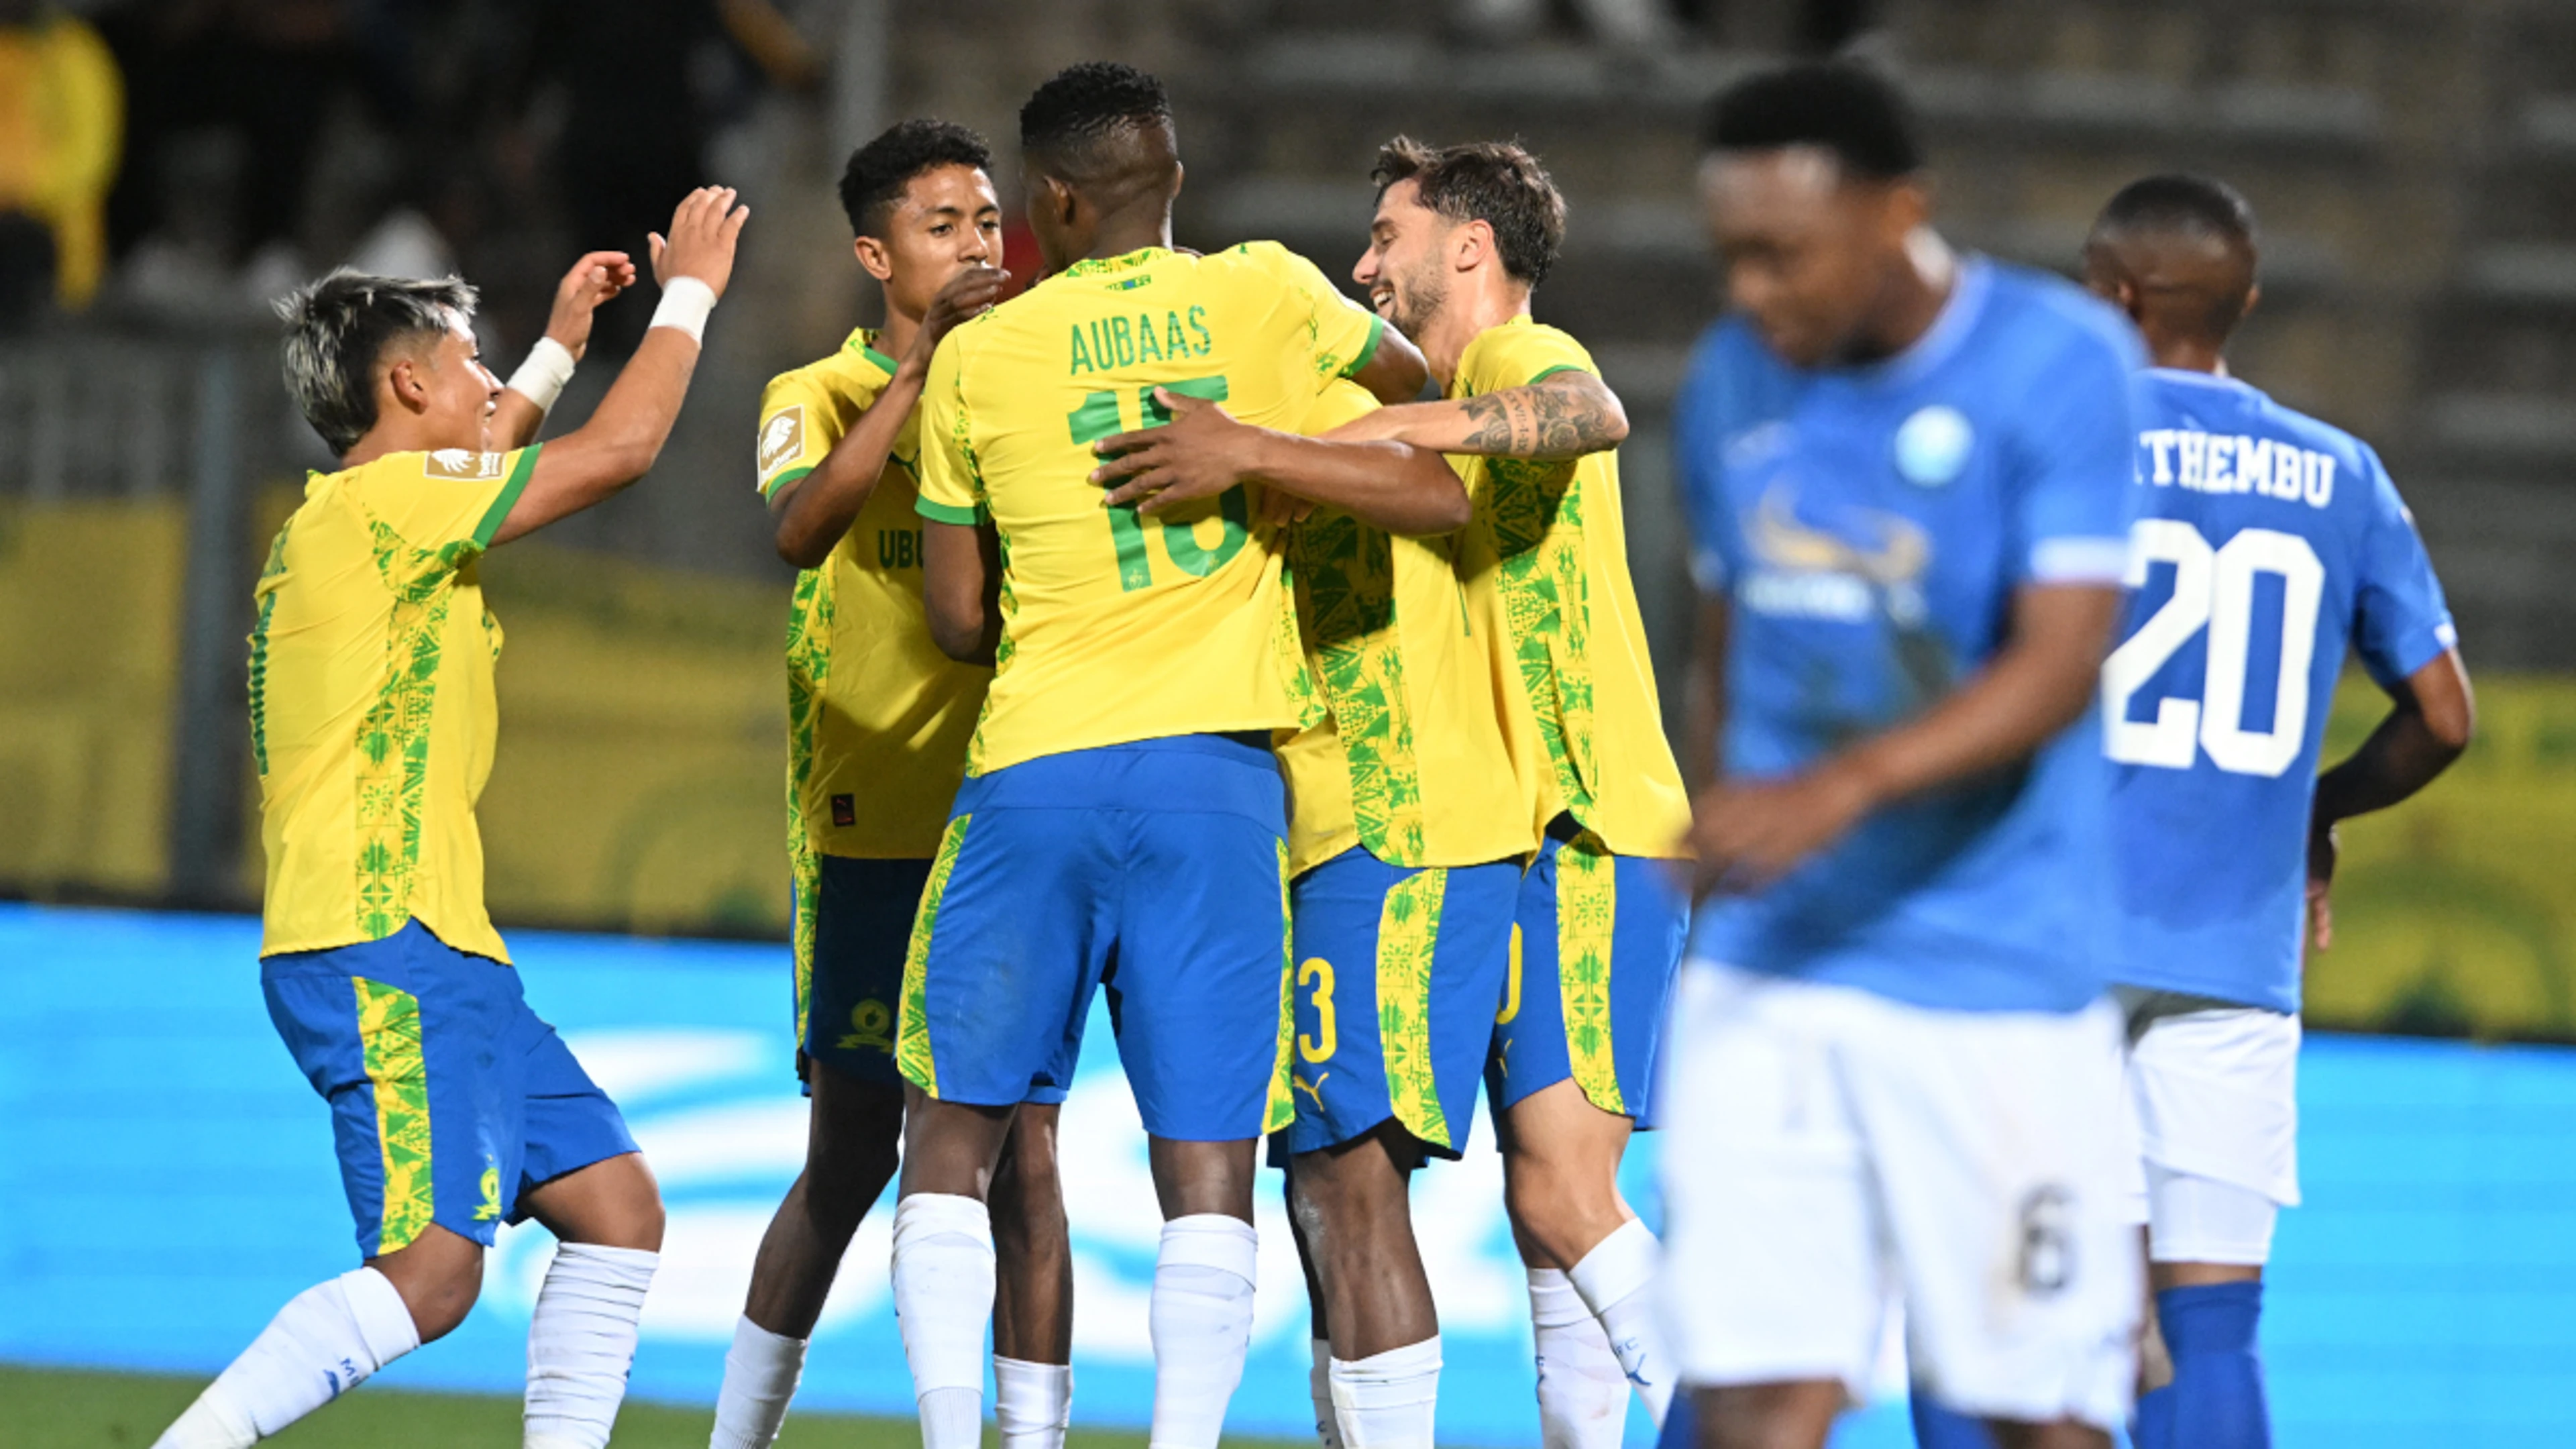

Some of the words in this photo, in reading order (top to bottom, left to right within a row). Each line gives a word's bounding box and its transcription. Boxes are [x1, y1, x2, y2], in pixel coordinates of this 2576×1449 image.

[1071, 305, 1210, 376] AUBAAS
[2135, 429, 2337, 508] THEMBU
[2101, 519, 2326, 777] 20
[1291, 957, 1337, 1063] 3
